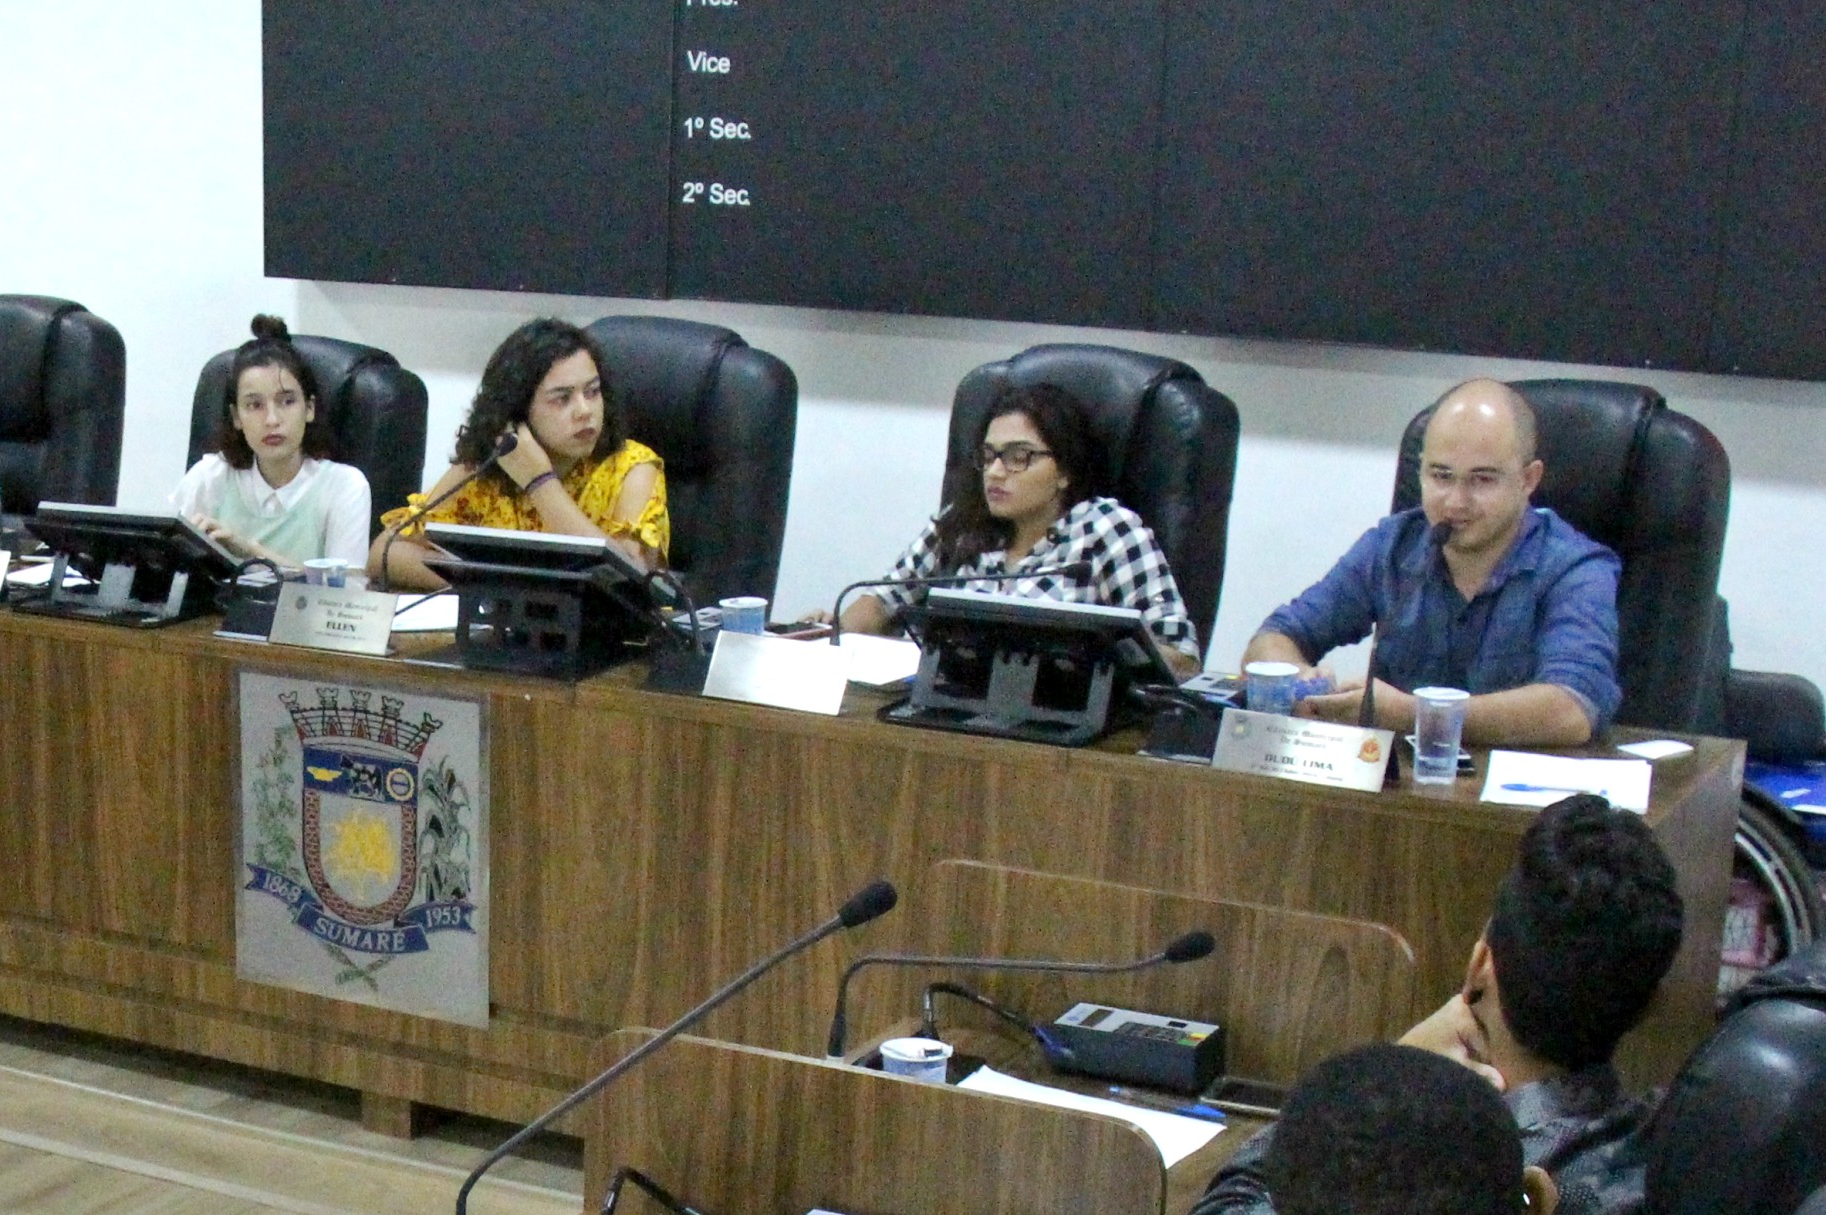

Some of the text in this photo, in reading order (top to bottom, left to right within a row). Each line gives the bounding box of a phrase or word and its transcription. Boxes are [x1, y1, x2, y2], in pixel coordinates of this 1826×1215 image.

[687, 50, 731, 74] Vice
[709, 117, 752, 139] Sec.
[709, 183, 751, 206] Sec.
[425, 905, 462, 929] 1953
[313, 917, 406, 951] SUMARÉ
